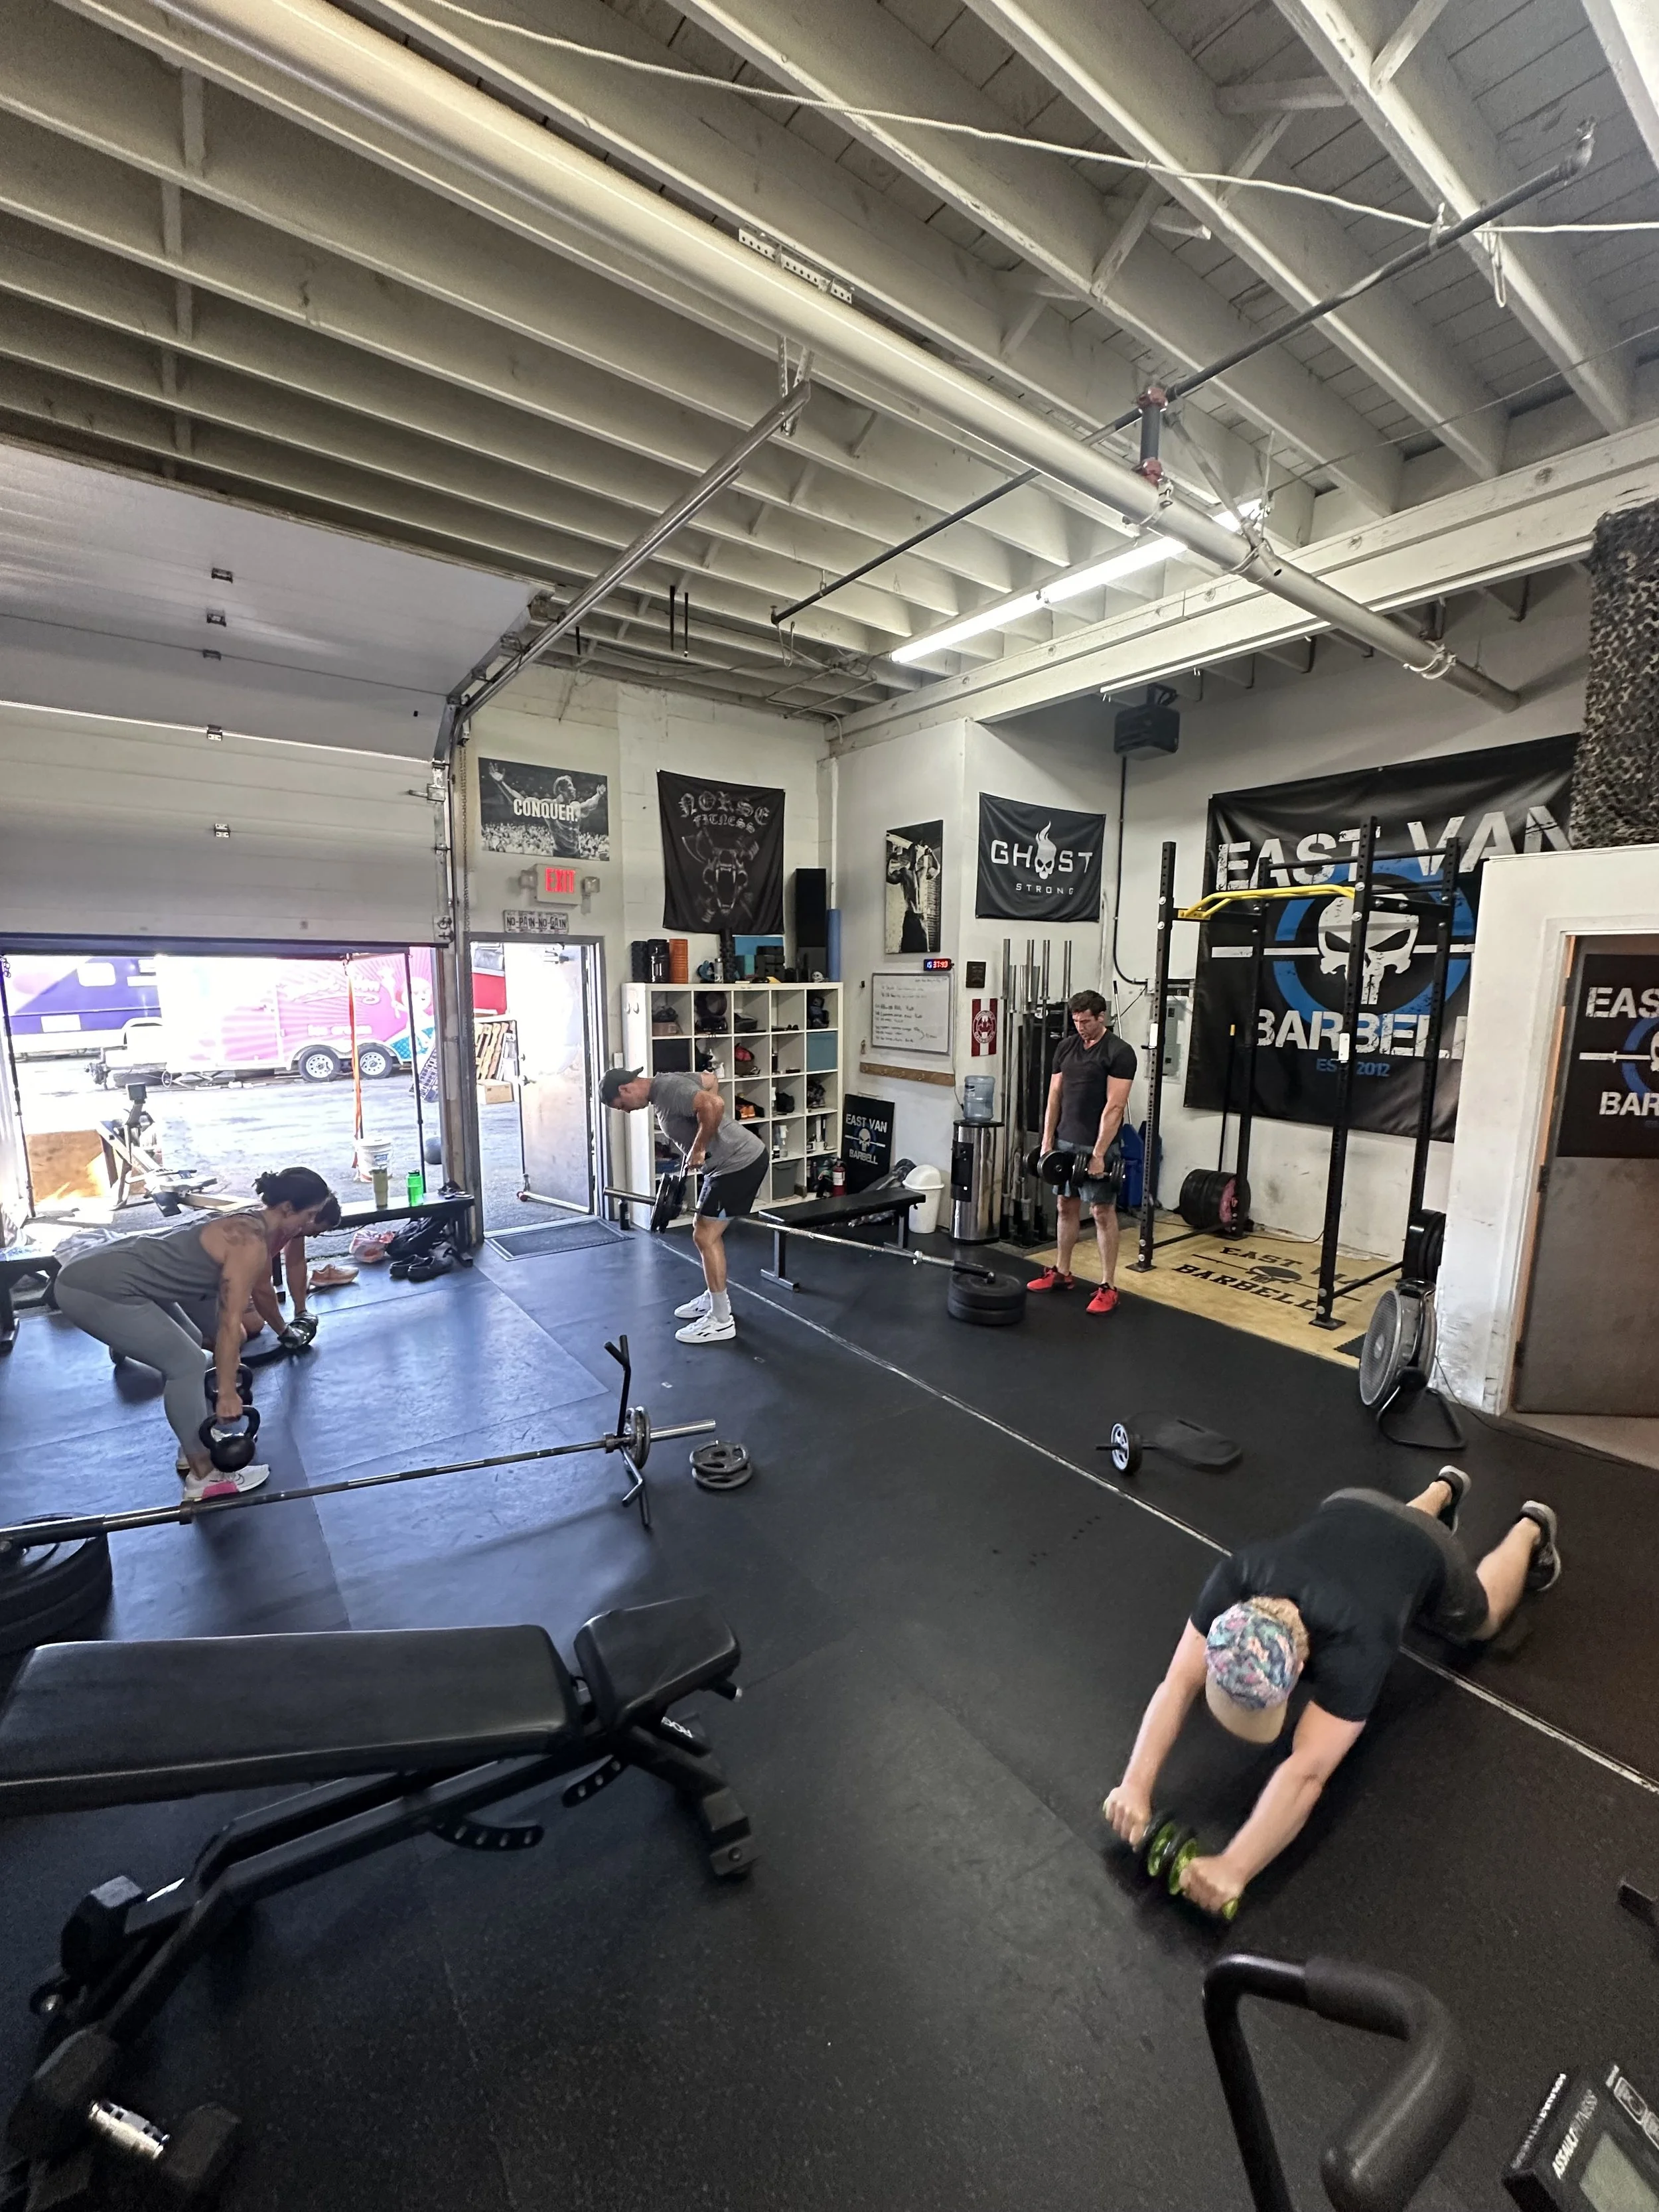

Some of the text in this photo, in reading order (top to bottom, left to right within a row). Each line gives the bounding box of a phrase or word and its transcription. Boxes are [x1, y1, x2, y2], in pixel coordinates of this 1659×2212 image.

[514, 798, 578, 822] CONQUER.
[678, 790, 770, 825] NORSE
[693, 814, 755, 834] FITNESS
[1216, 826, 1381, 891] EAST
[545, 867, 576, 893] EXIT
[1015, 883, 1074, 895] STRONG
[1316, 1058, 1391, 1077] ES 2012
[845, 1113, 888, 1133] EAST VAN
[849, 1148, 879, 1165] BARBELL
[1219, 1246, 1303, 1268] EAST
[1172, 1264, 1318, 1311] BARBELL
